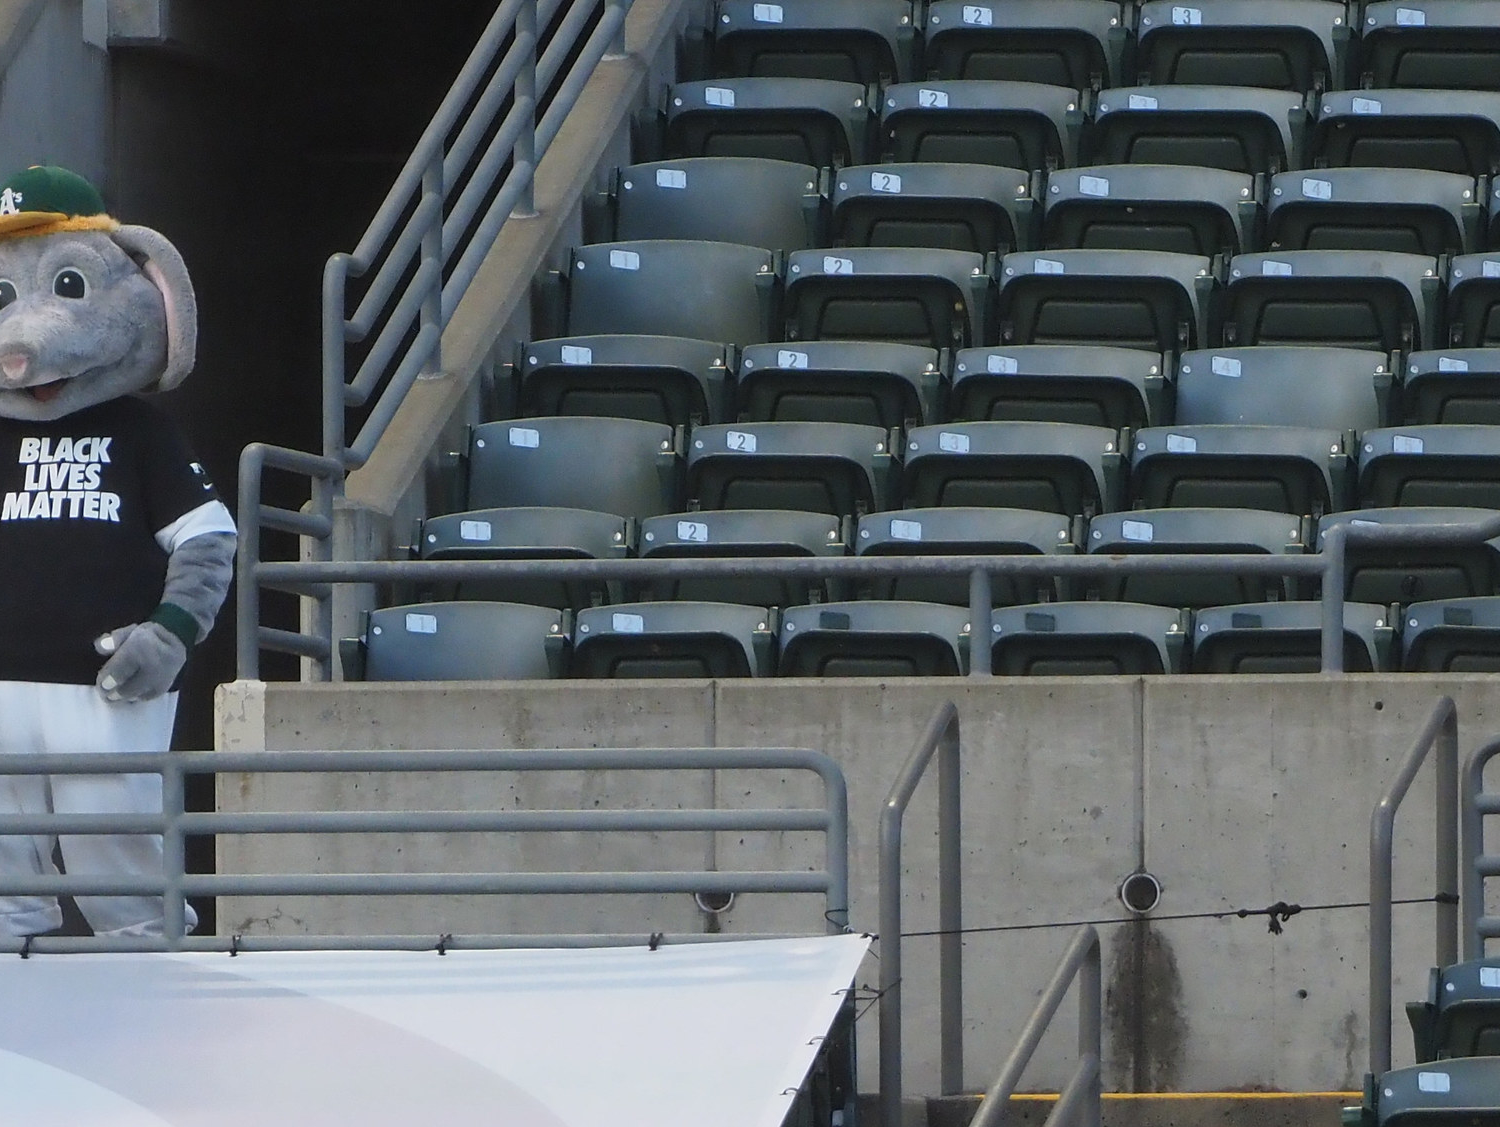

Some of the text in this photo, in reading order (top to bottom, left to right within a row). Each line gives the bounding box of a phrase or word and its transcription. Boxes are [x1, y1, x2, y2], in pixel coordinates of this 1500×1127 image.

[973, 8, 982, 24] 2
[1183, 9, 1191, 25] 3
[929, 92, 937, 107] 2
[882, 175, 891, 191] 2
[1312, 182, 1321, 196] 4
[0, 188, 23, 215] A's
[834, 259, 842, 274] 2
[789, 353, 797, 368] 2
[18, 437, 112, 463] BLACK
[737, 434, 746, 450] 2
[950, 436, 959, 450] 3
[23, 463, 101, 491] LIVES
[1, 491, 120, 522] MATTER
[688, 523, 697, 540] 2
[623, 616, 632, 631] 2
